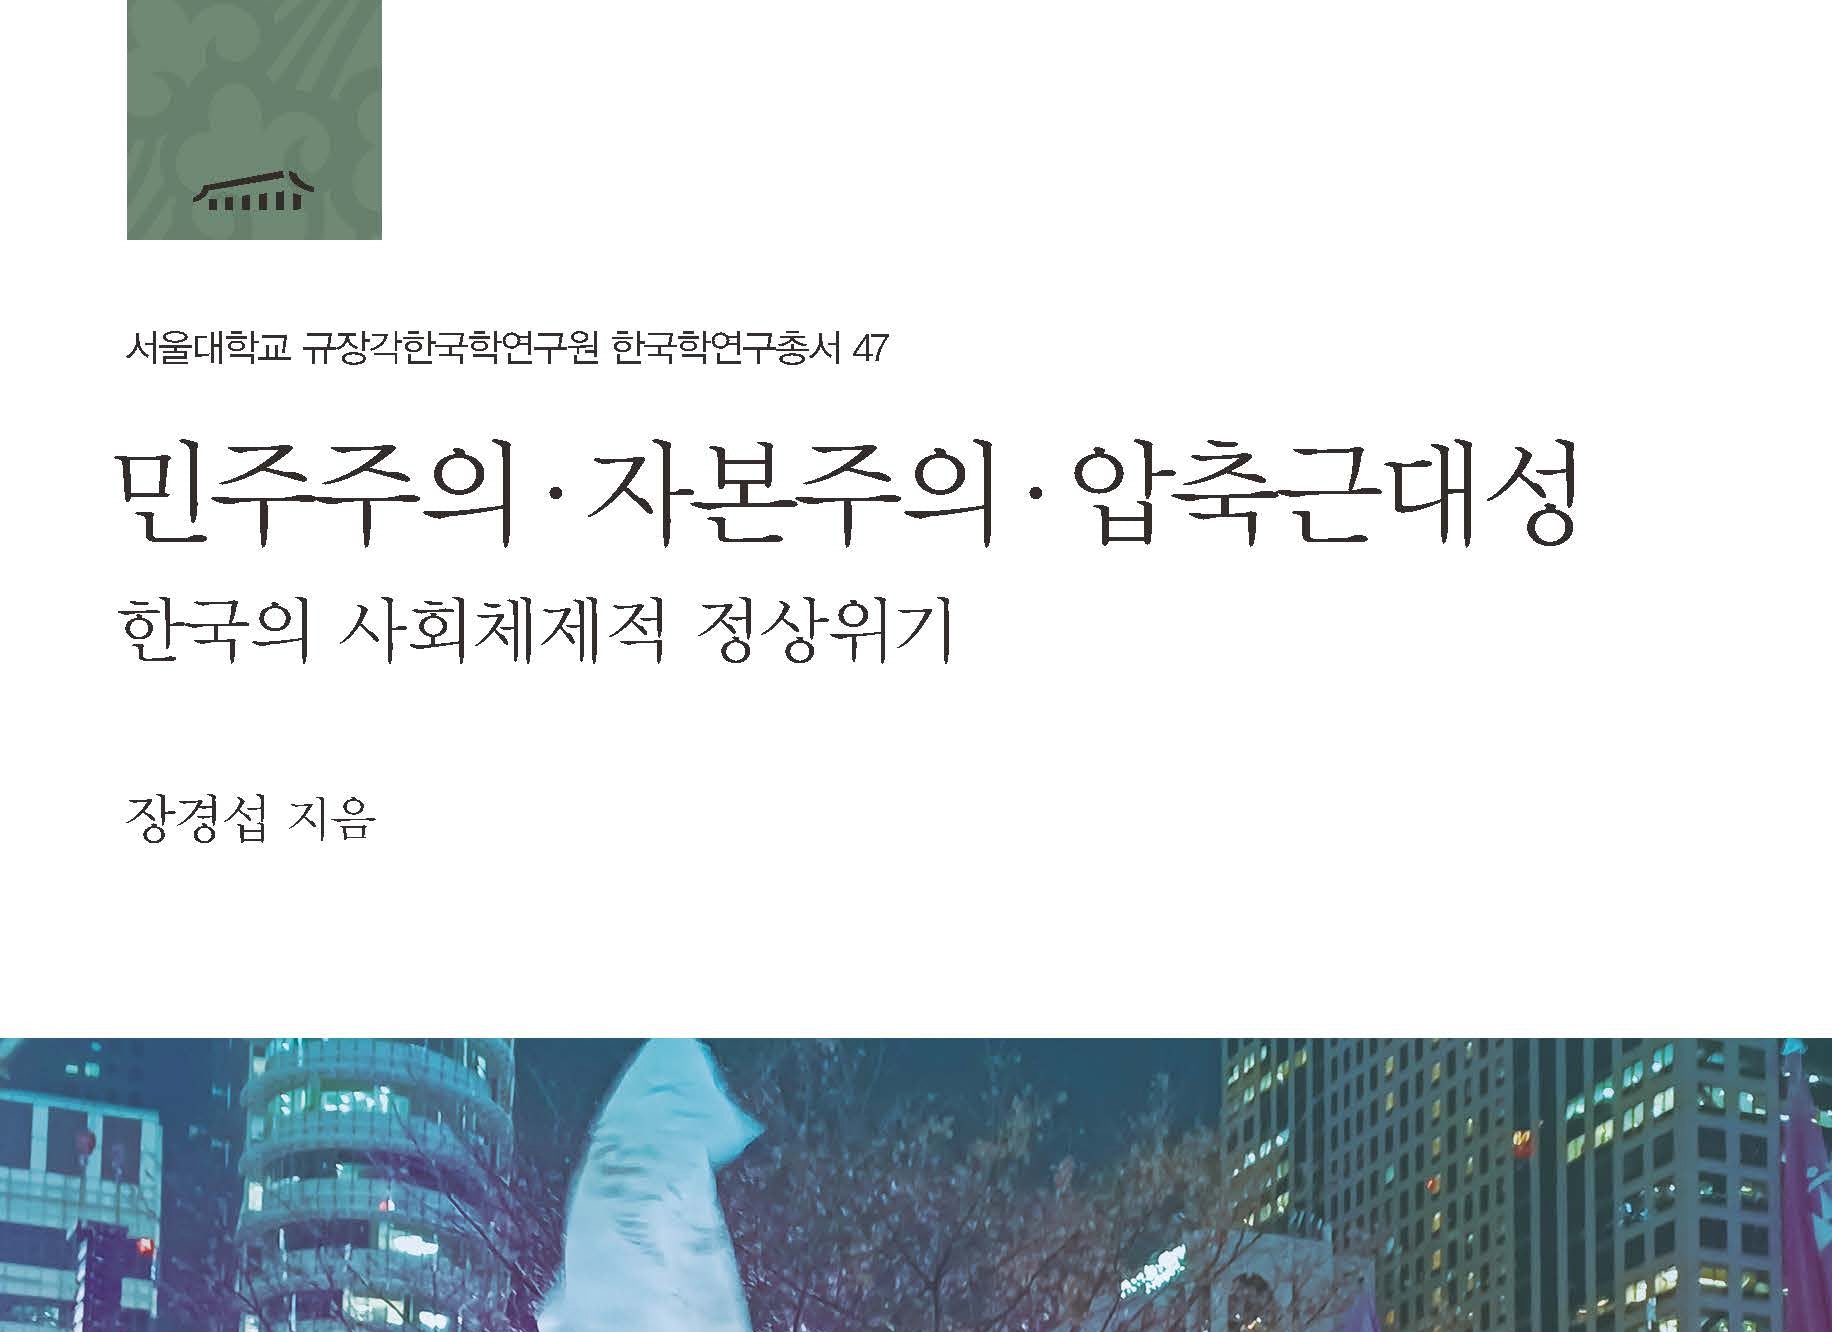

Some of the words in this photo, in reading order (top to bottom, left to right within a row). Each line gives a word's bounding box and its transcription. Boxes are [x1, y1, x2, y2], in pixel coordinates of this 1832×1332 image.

[126, 331, 292, 365] 서울대학교
[302, 331, 599, 366] 규장각한국학연구원
[611, 331, 840, 366] 한국학연구총서
[852, 333, 890, 362] 47
[114, 438, 512, 549] 민주주의
[587, 438, 993, 549] 자본주의
[1073, 438, 1575, 549] 압축근대성
[118, 596, 308, 665] 한국의
[339, 596, 663, 665] 사회체제적
[697, 596, 950, 665] 정상위기
[126, 794, 265, 844] 장경섭
[288, 796, 377, 842] 지음
